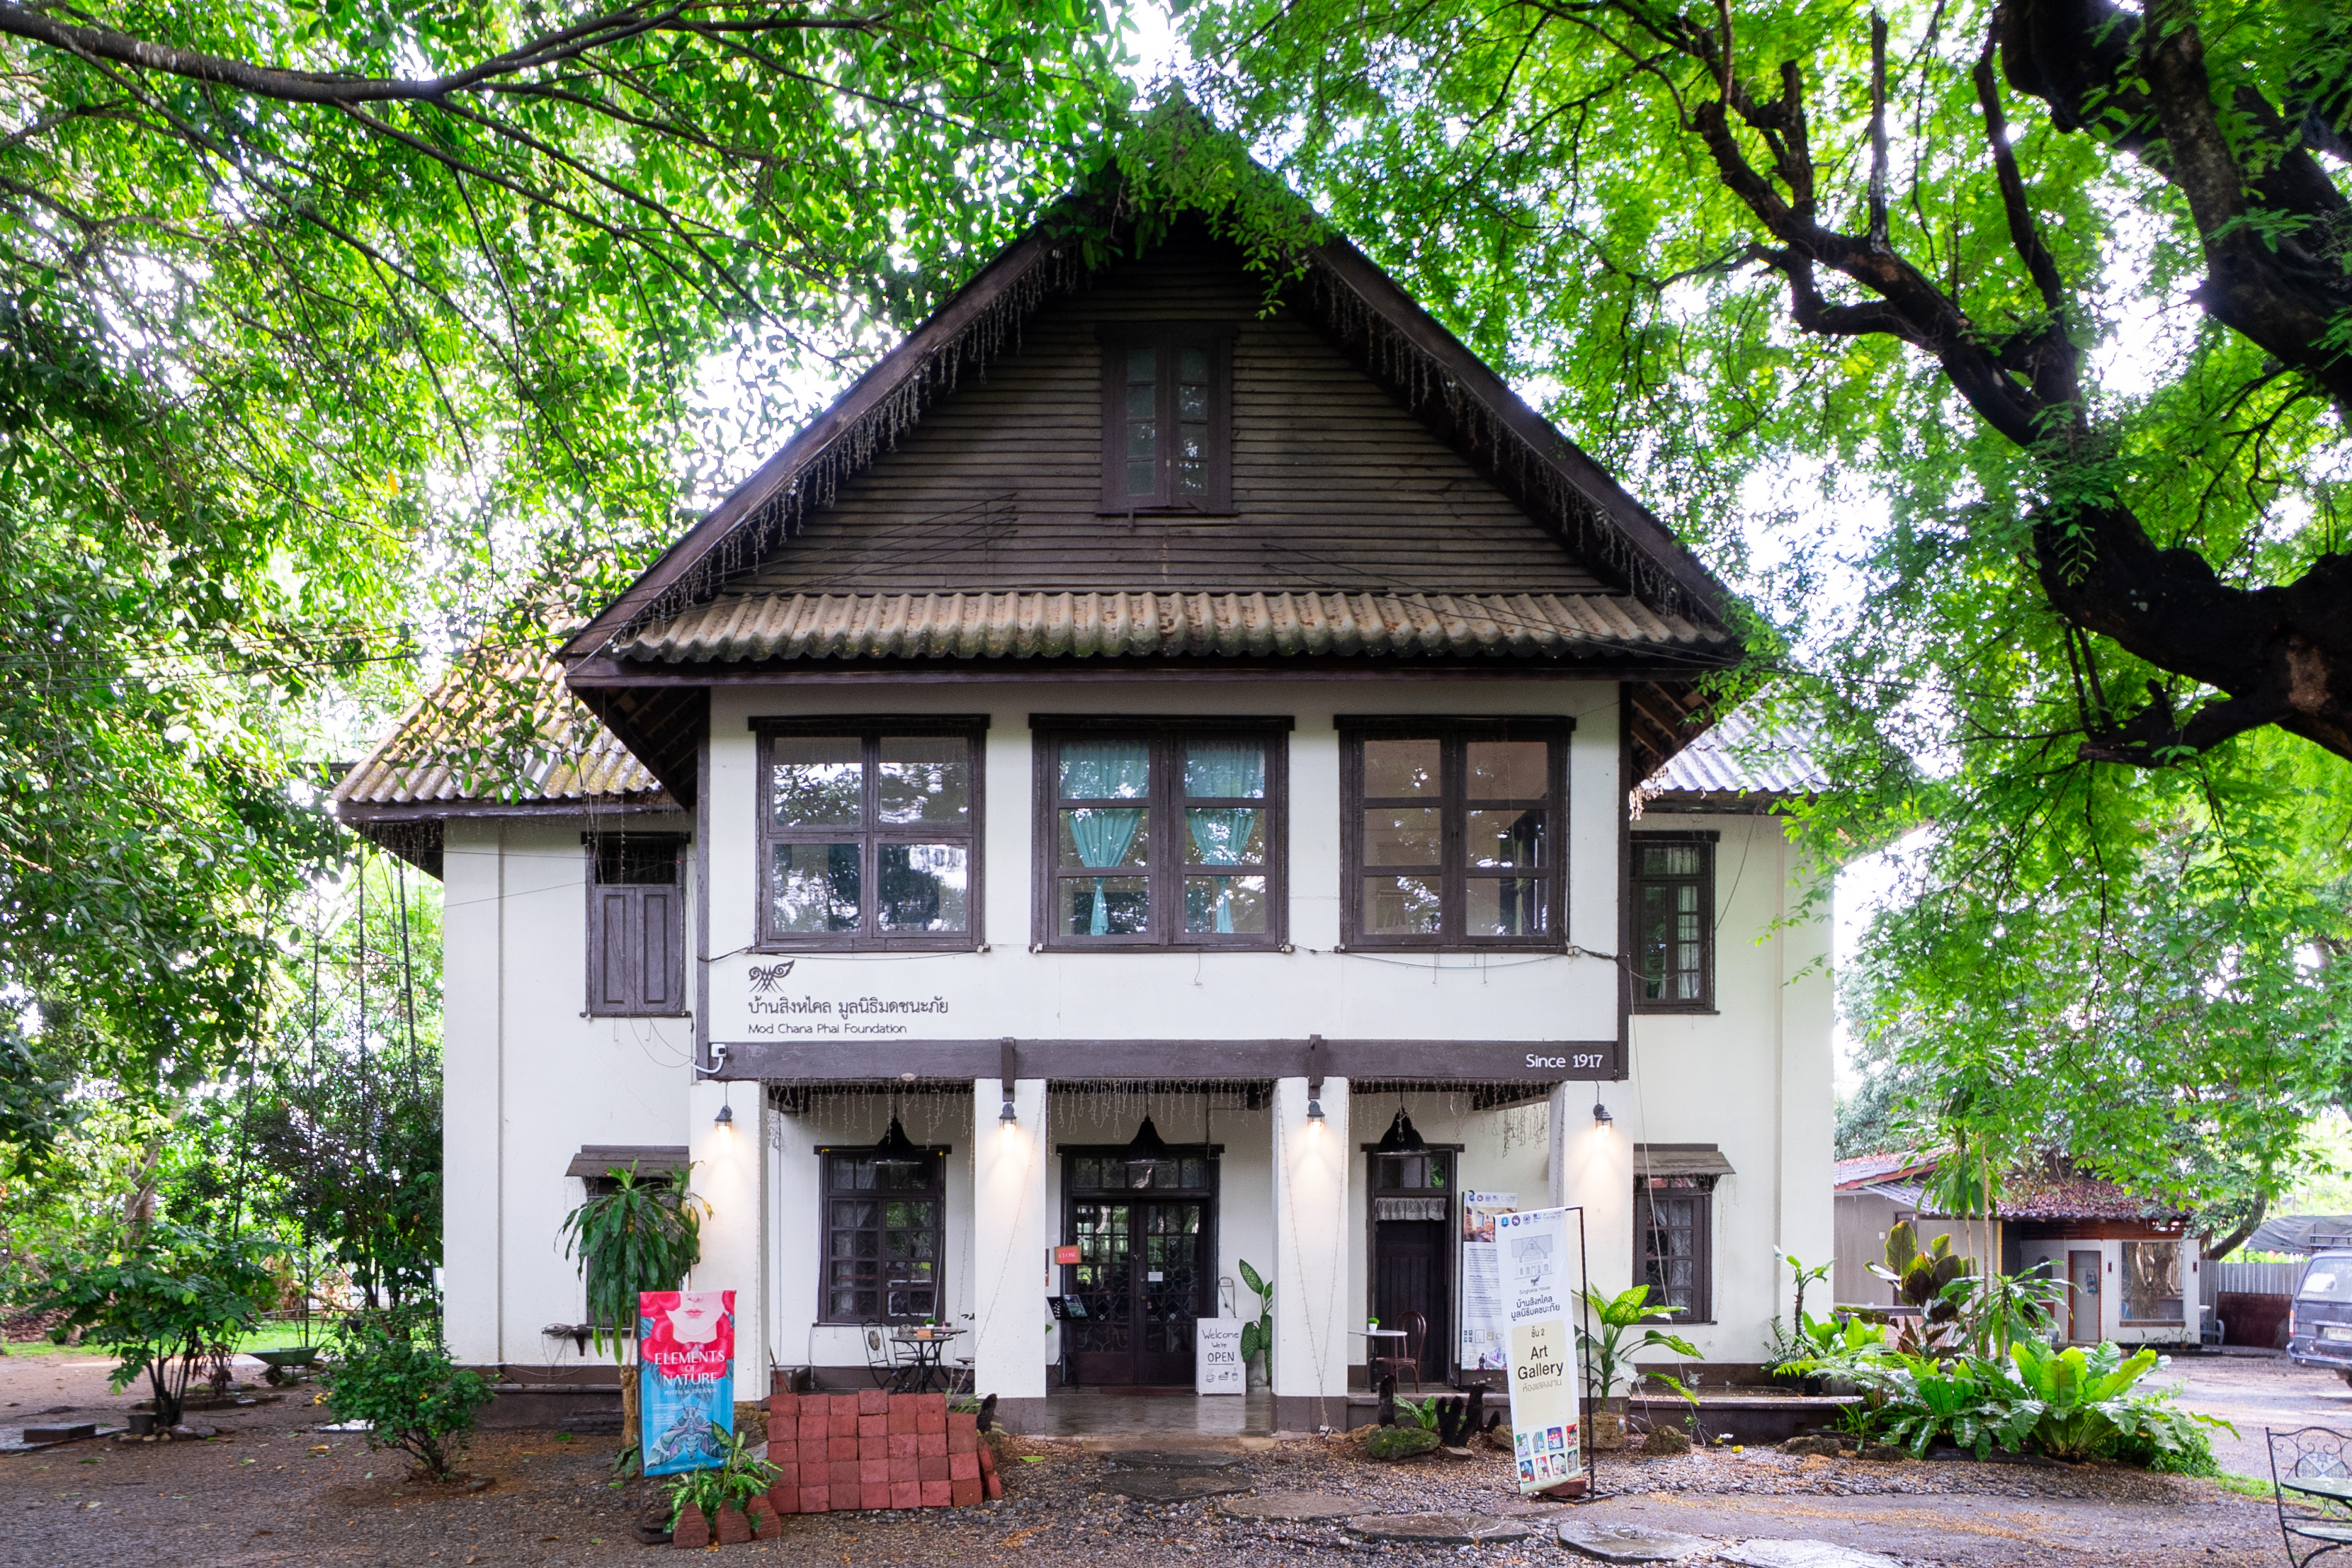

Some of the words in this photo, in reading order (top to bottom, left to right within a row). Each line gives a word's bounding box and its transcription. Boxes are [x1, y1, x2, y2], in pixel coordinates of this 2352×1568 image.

[748, 995, 831, 1014] บ้านสิงหไคล
[838, 995, 949, 1020] มูลนิธิมดชนะภัย
[748, 1023, 774, 1034] Mod
[778, 1023, 813, 1034] Chana
[843, 1023, 907, 1034] Foundation
[1526, 1053, 1567, 1068] Since
[1572, 1053, 1604, 1068] 1917
[1201, 1328, 1239, 1339] Welcome
[1540, 1328, 1545, 1336] 2
[654, 1350, 726, 1365] ELEMENTS
[1208, 1351, 1235, 1363] OPEN
[1530, 1344, 1548, 1360] Art
[684, 1364, 697, 1373] OF
[1517, 1361, 1564, 1380] Gallery
[662, 1372, 718, 1386] NATURE
